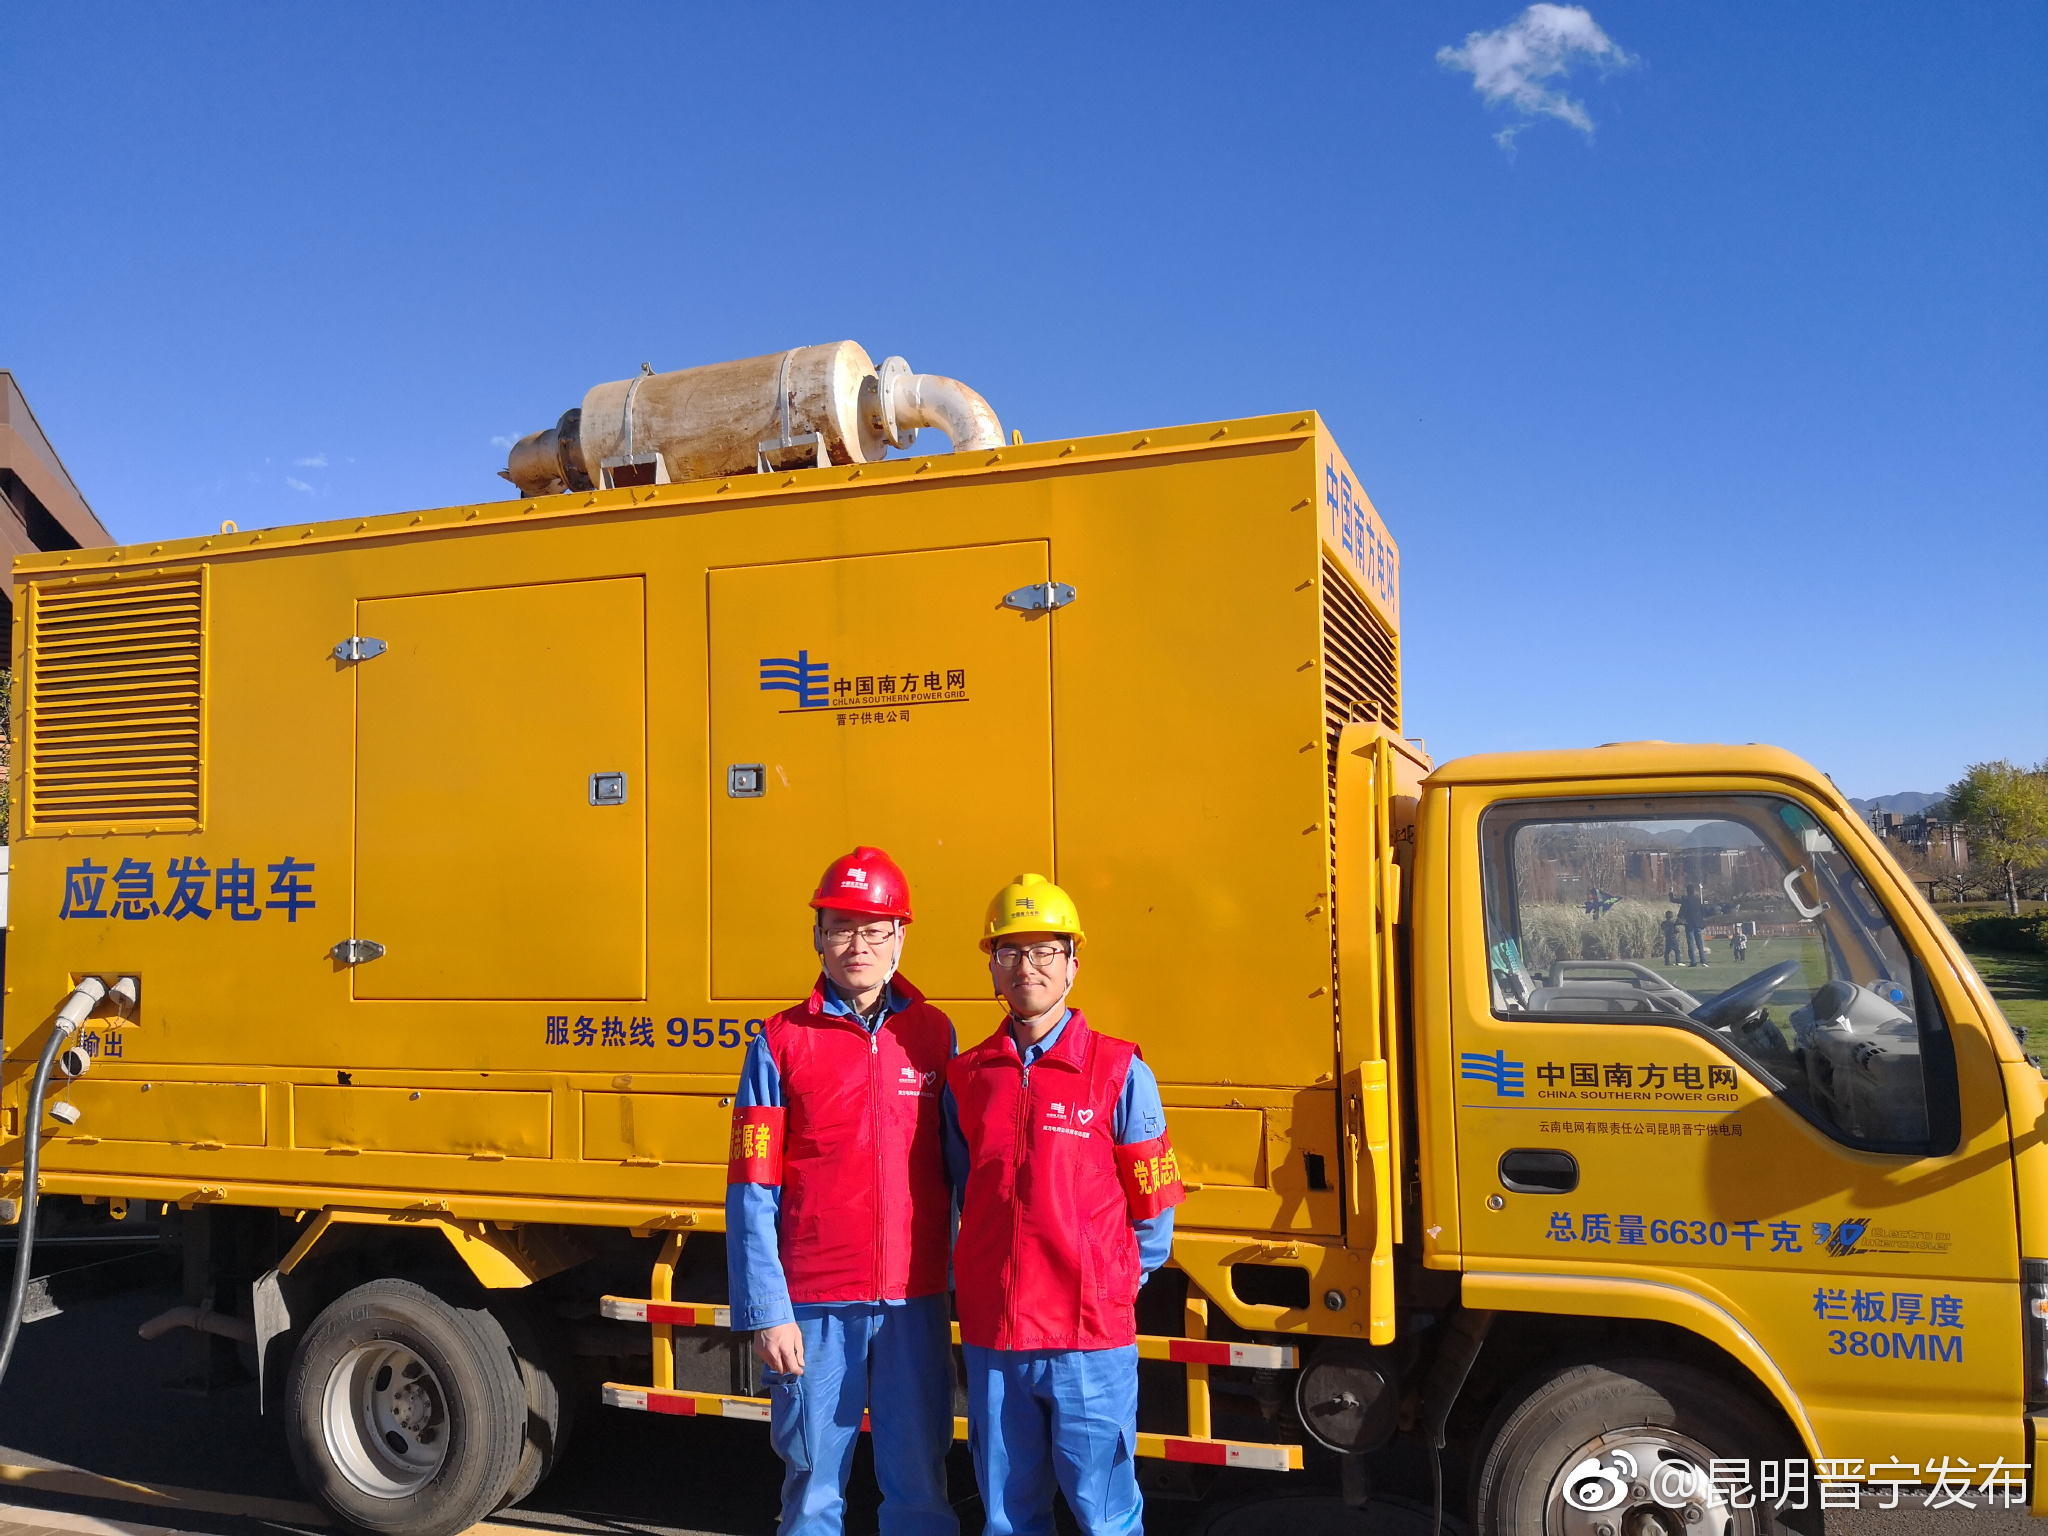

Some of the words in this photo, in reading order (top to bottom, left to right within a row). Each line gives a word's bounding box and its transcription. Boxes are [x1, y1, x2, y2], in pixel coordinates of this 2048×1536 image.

[1326, 452, 1395, 613] 中国南方电网
[833, 669, 966, 698] 中国南方电网
[862, 695, 909, 704] SOUTHERN
[911, 692, 942, 701] POWER
[944, 690, 966, 699] GRID
[836, 710, 910, 726] 晋宁供电公司
[58, 856, 317, 923] 应急发电车
[545, 1015, 655, 1048] 服务热线
[1536, 1061, 1739, 1090] 中国南方电网
[1538, 1090, 1577, 1099] CHINA
[1580, 1090, 1651, 1100] SOUTHERN
[1654, 1091, 1703, 1101] POWER
[1706, 1092, 1739, 1102] GRID
[1538, 1120, 1743, 1137] 云南电网有限责任公司昆明晋宁供电局
[1545, 1210, 1803, 1253] 总质量6630千克
[1813, 1287, 1966, 1330] 栏板厚度
[1828, 1329, 1964, 1363] 380MM
